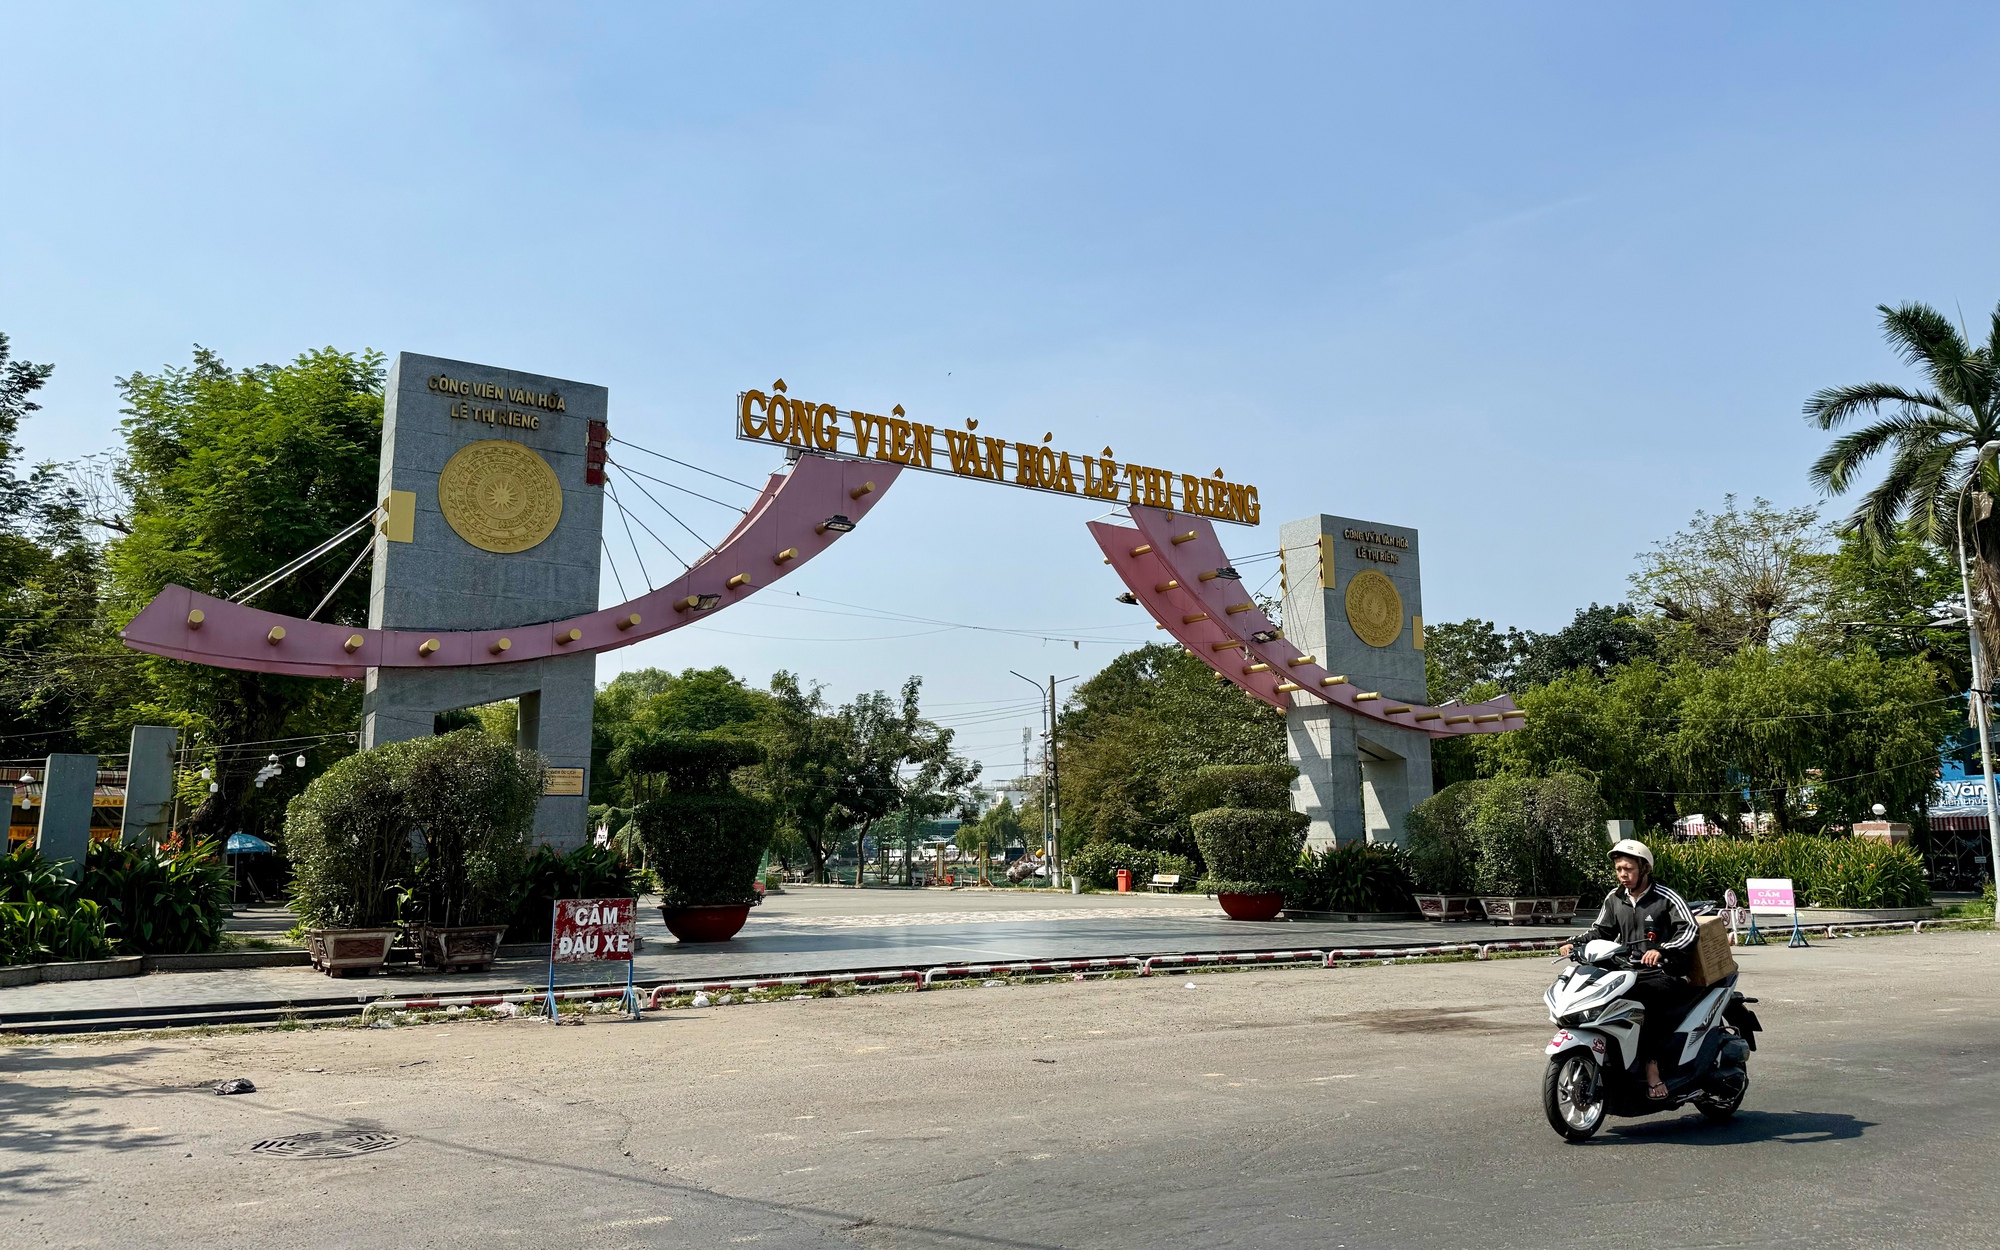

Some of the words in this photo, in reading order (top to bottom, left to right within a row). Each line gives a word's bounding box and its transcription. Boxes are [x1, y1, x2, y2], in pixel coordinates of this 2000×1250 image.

[428, 374, 469, 395] CÔNG
[472, 382, 504, 400] VIÊN
[508, 388, 535, 405] VĂN
[538, 390, 566, 411] HÓA
[451, 402, 468, 419] LÊ
[472, 407, 495, 428] THỊ
[498, 410, 540, 430] RIÊNG
[742, 378, 840, 452] CÔNG
[850, 404, 934, 468] VIÊN
[945, 417, 1005, 481] VĂN
[1015, 431, 1077, 493] HÓA
[1082, 446, 1119, 500] LÊ
[1182, 467, 1261, 525] RIÊNG
[575, 901, 618, 926] CẤM
[559, 932, 599, 958] ĐẬU
[603, 934, 629, 953] XE
